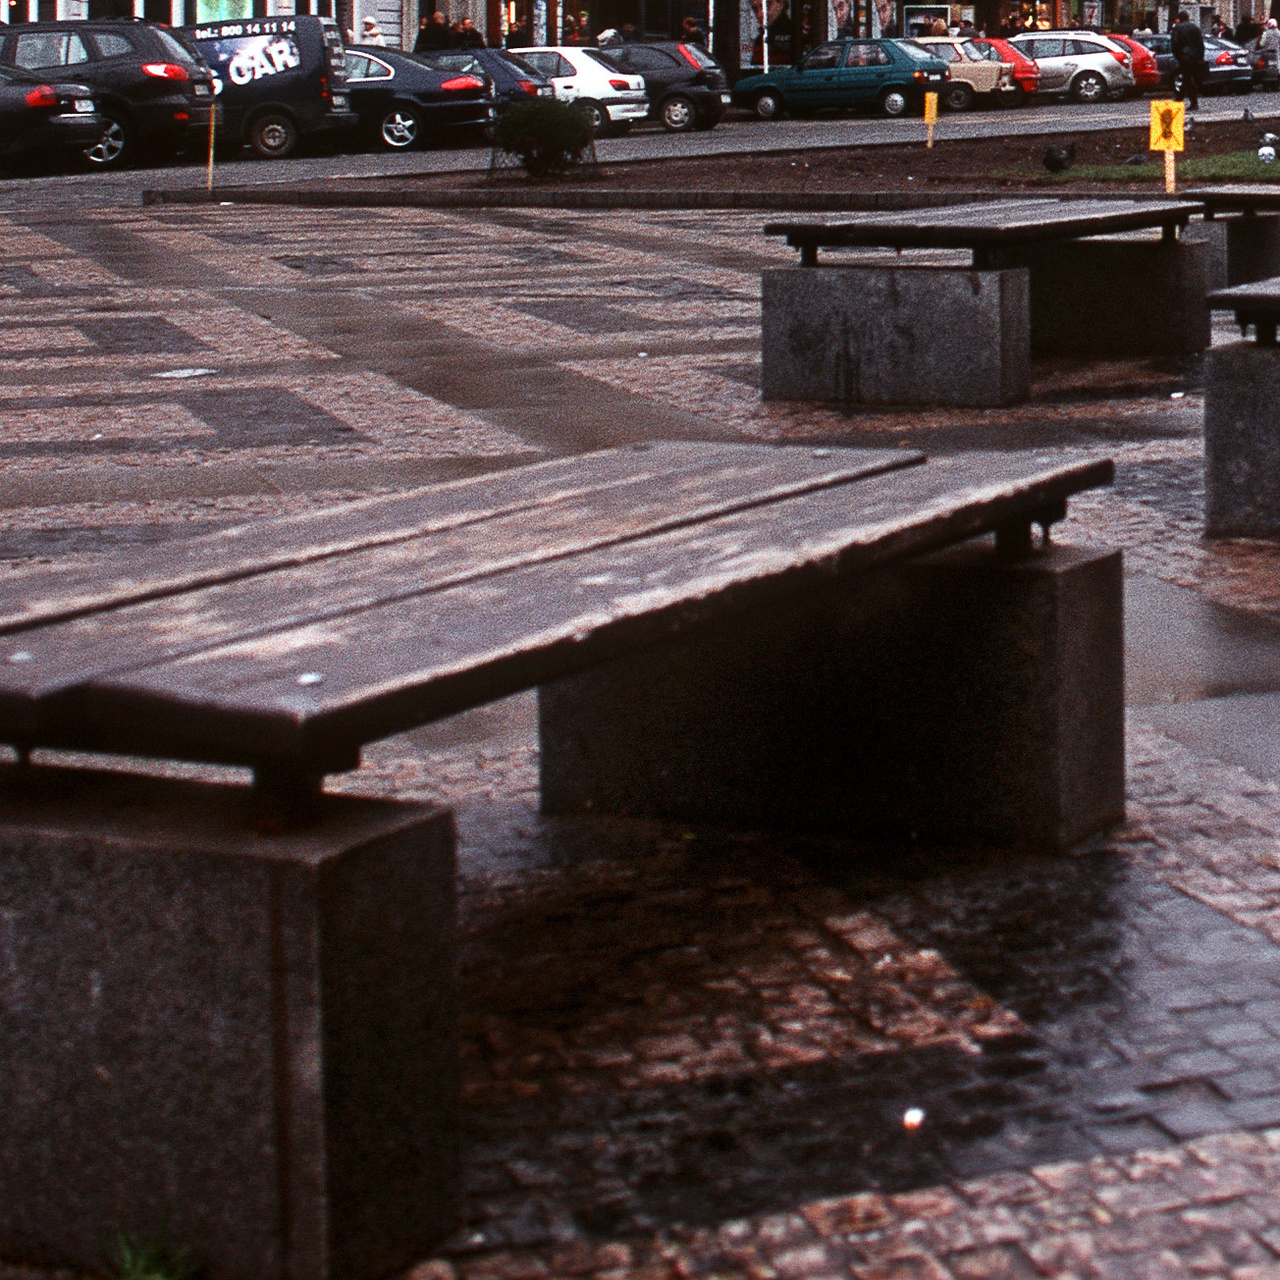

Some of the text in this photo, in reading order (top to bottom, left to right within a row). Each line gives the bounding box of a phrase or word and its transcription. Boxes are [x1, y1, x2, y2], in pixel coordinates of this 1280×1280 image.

[246, 22, 260, 35] 14
[281, 20, 296, 32] 14
[229, 40, 300, 86] CAR
